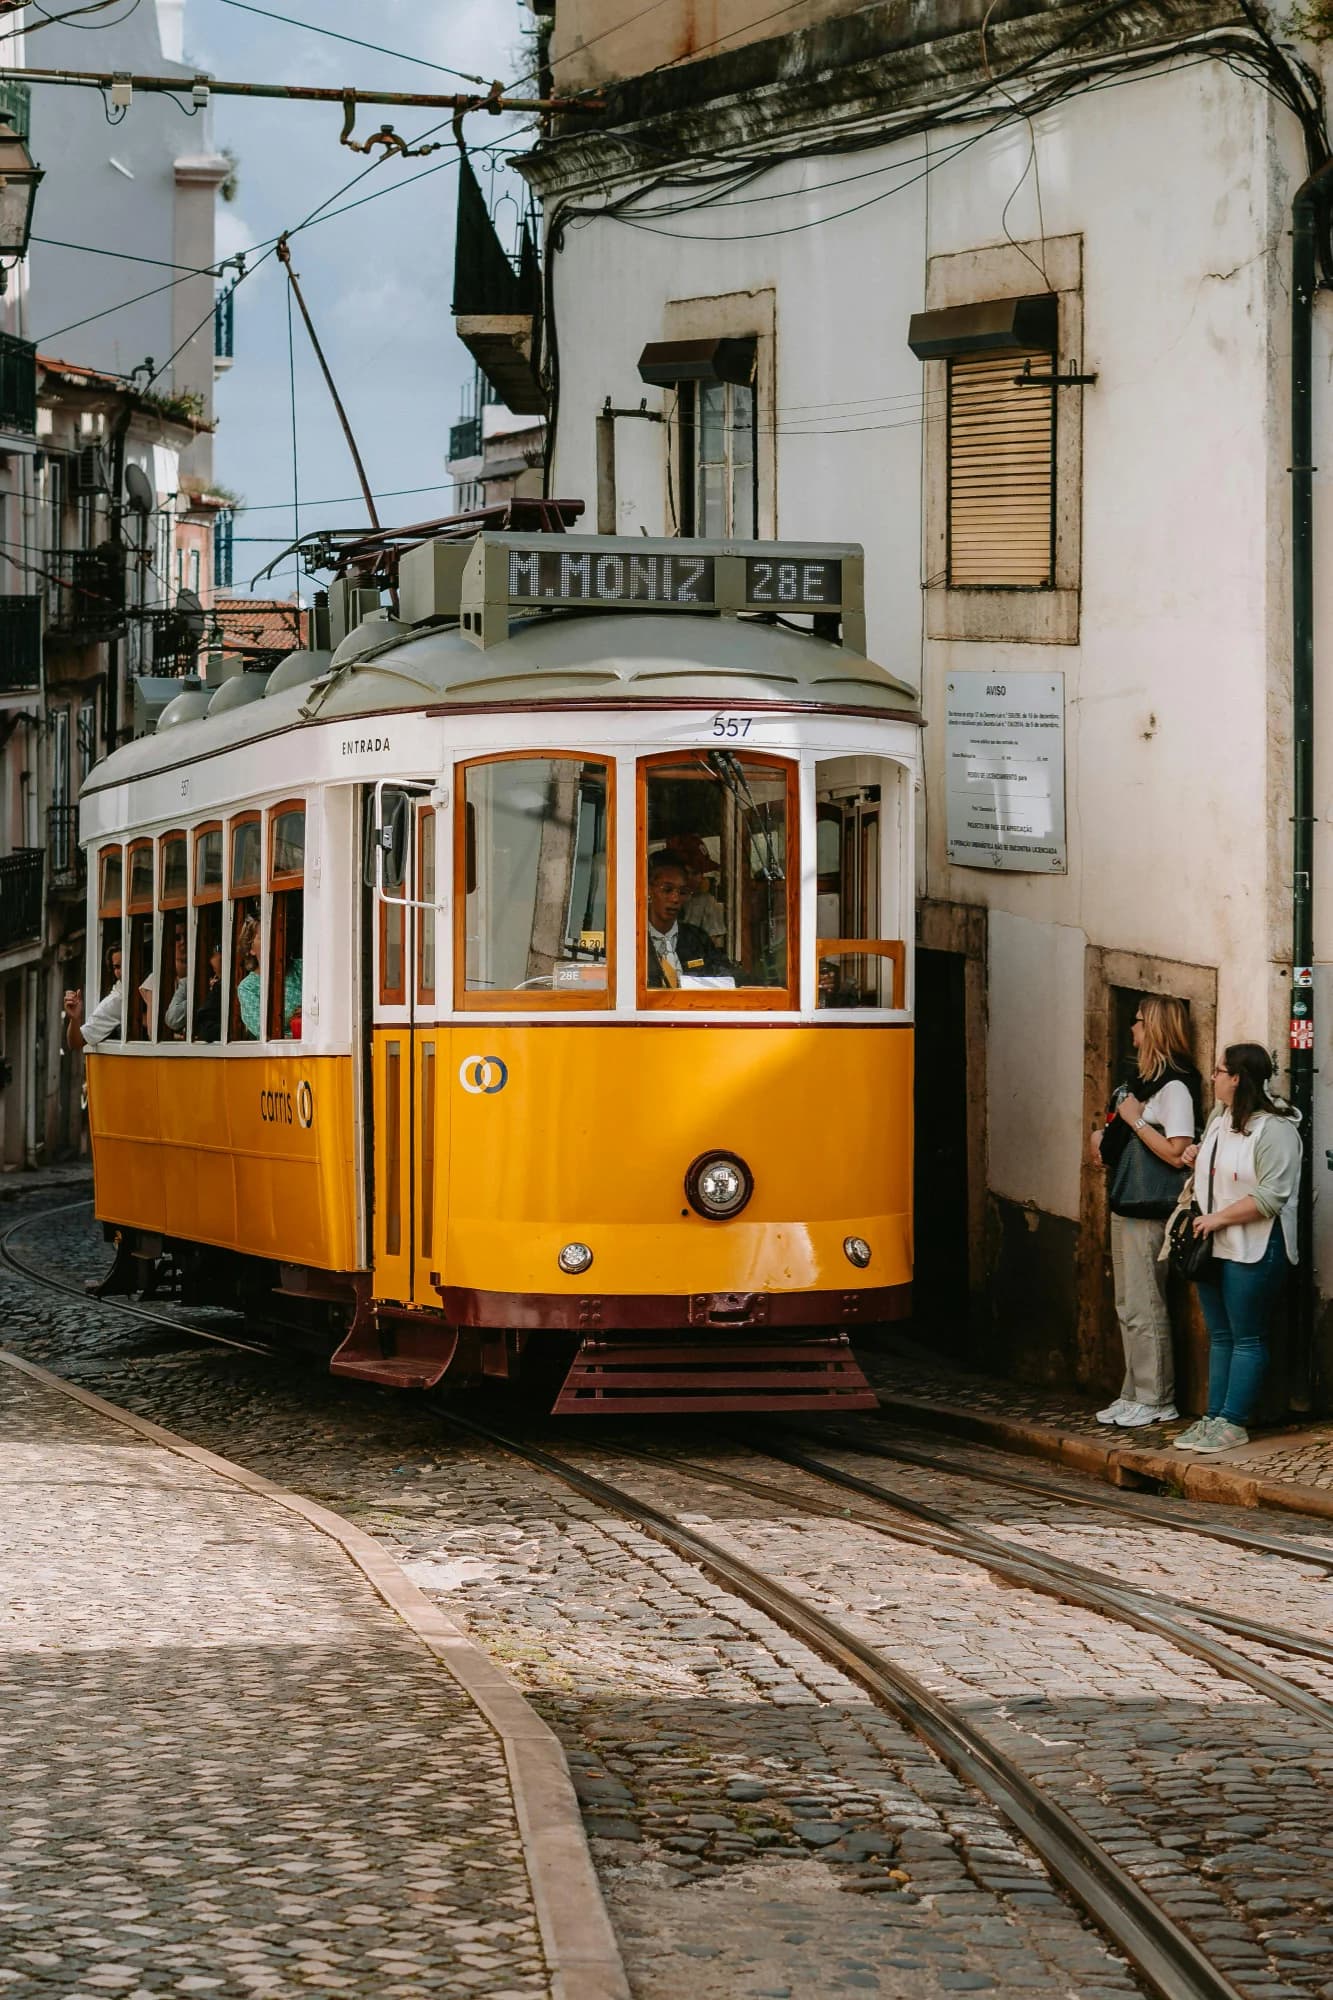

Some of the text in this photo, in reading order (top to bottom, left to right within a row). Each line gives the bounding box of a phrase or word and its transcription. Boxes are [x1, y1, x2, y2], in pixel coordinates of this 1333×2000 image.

[508, 550, 825, 602] M.MONIZ 28E
[986, 685, 1007, 697] AVISO
[713, 717, 752, 737] 557
[341, 737, 391, 756] ENTRADA
[181, 779, 190, 797] 557
[559, 970, 580, 981] 28E
[260, 1080, 292, 1125] carris
